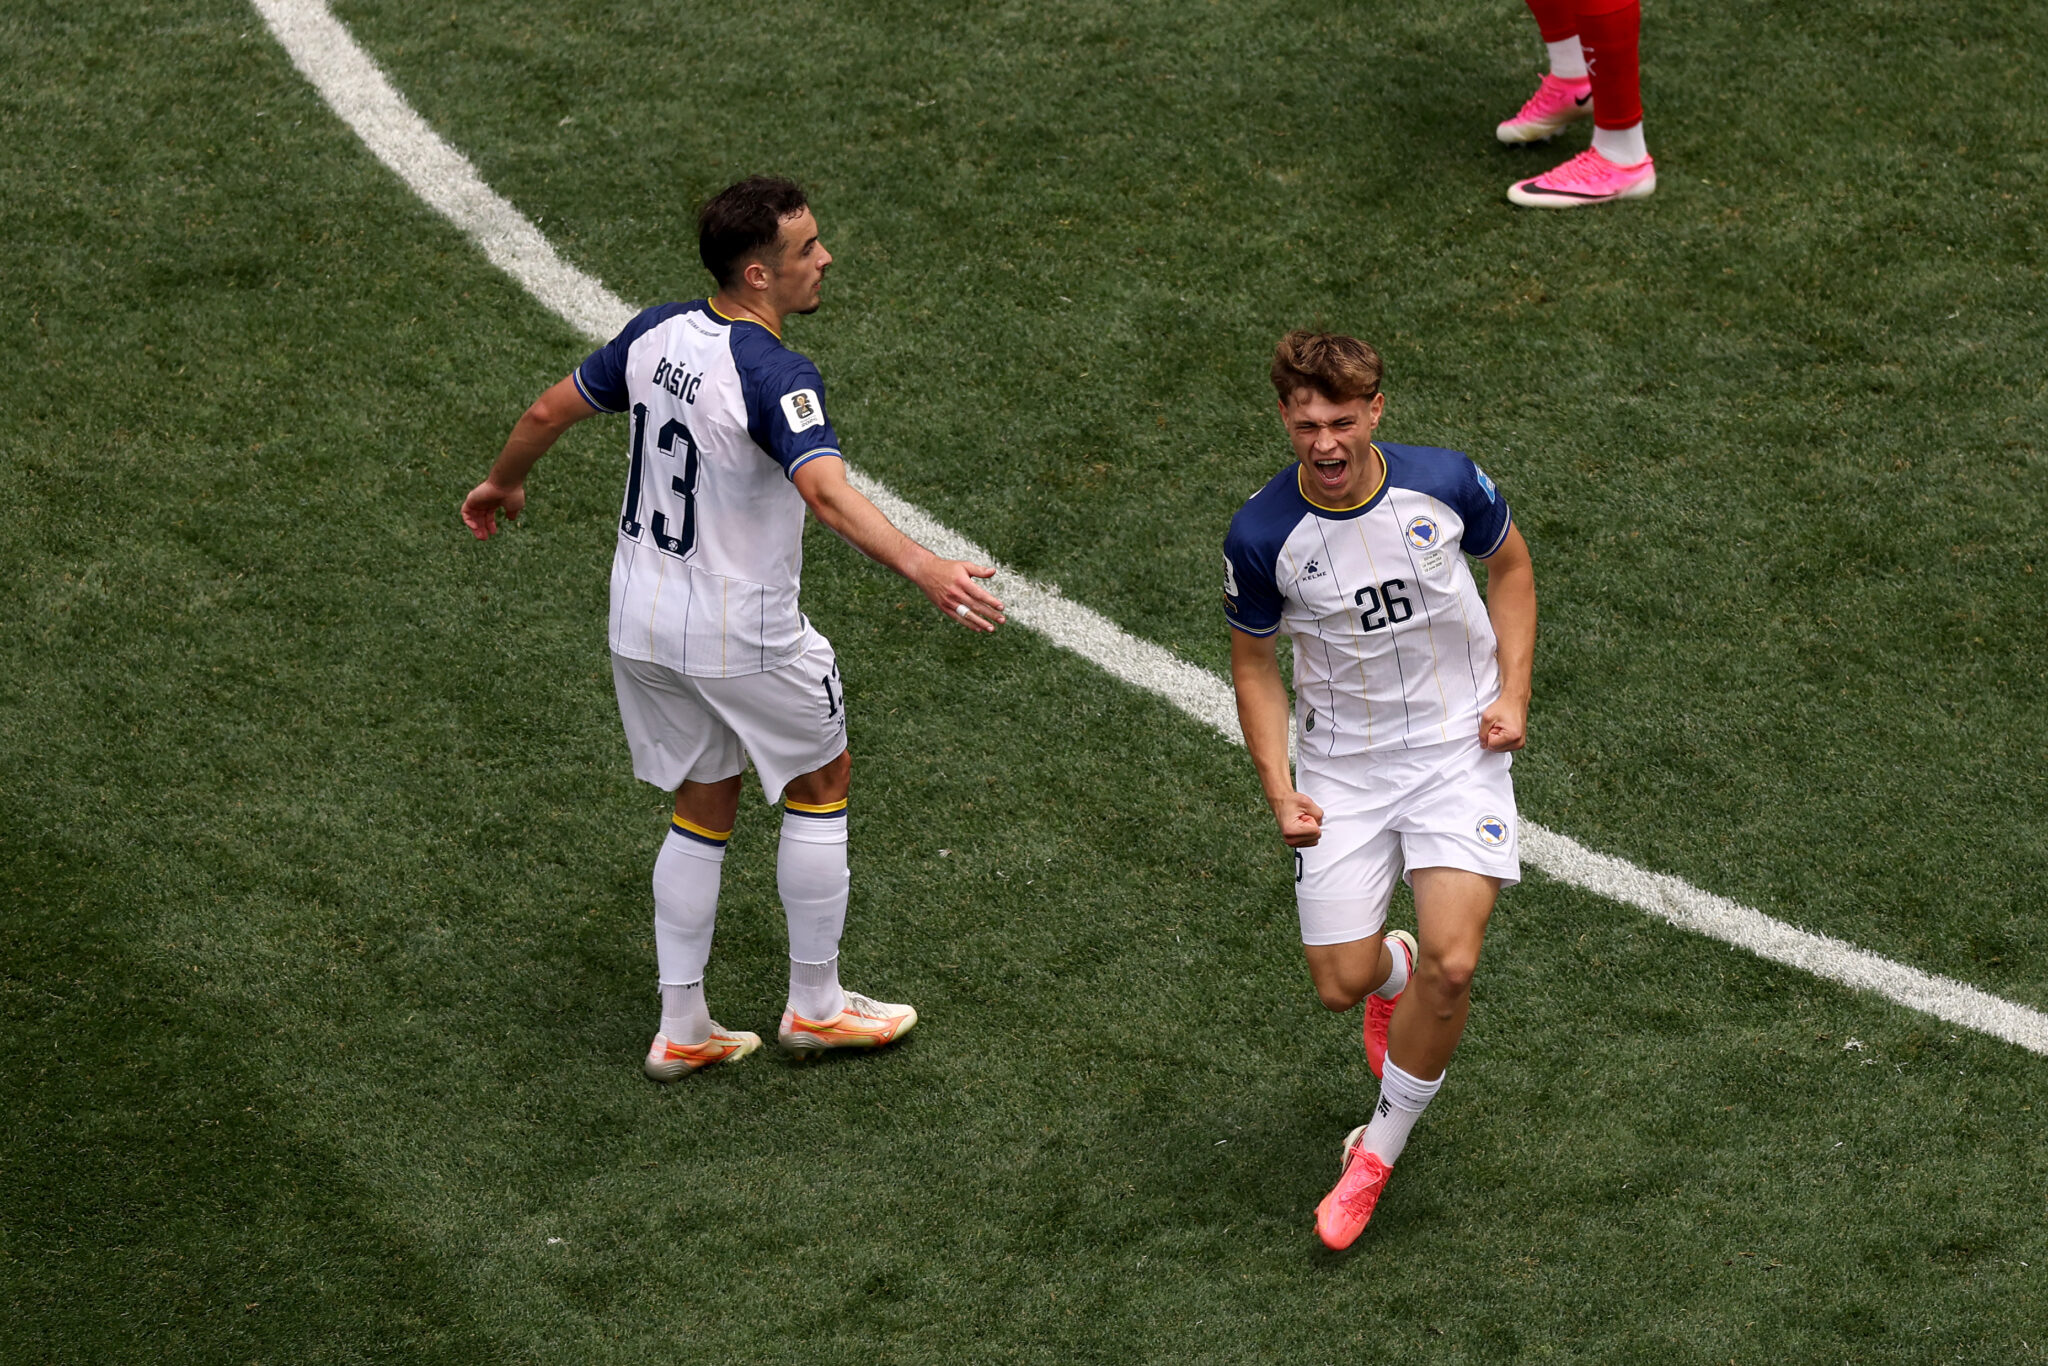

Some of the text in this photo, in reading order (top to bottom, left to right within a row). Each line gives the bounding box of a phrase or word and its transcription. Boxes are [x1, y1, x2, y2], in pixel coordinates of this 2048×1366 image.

[621, 402, 700, 562] 13
[1302, 571, 1327, 582] KELME
[1354, 578, 1415, 632] 26
